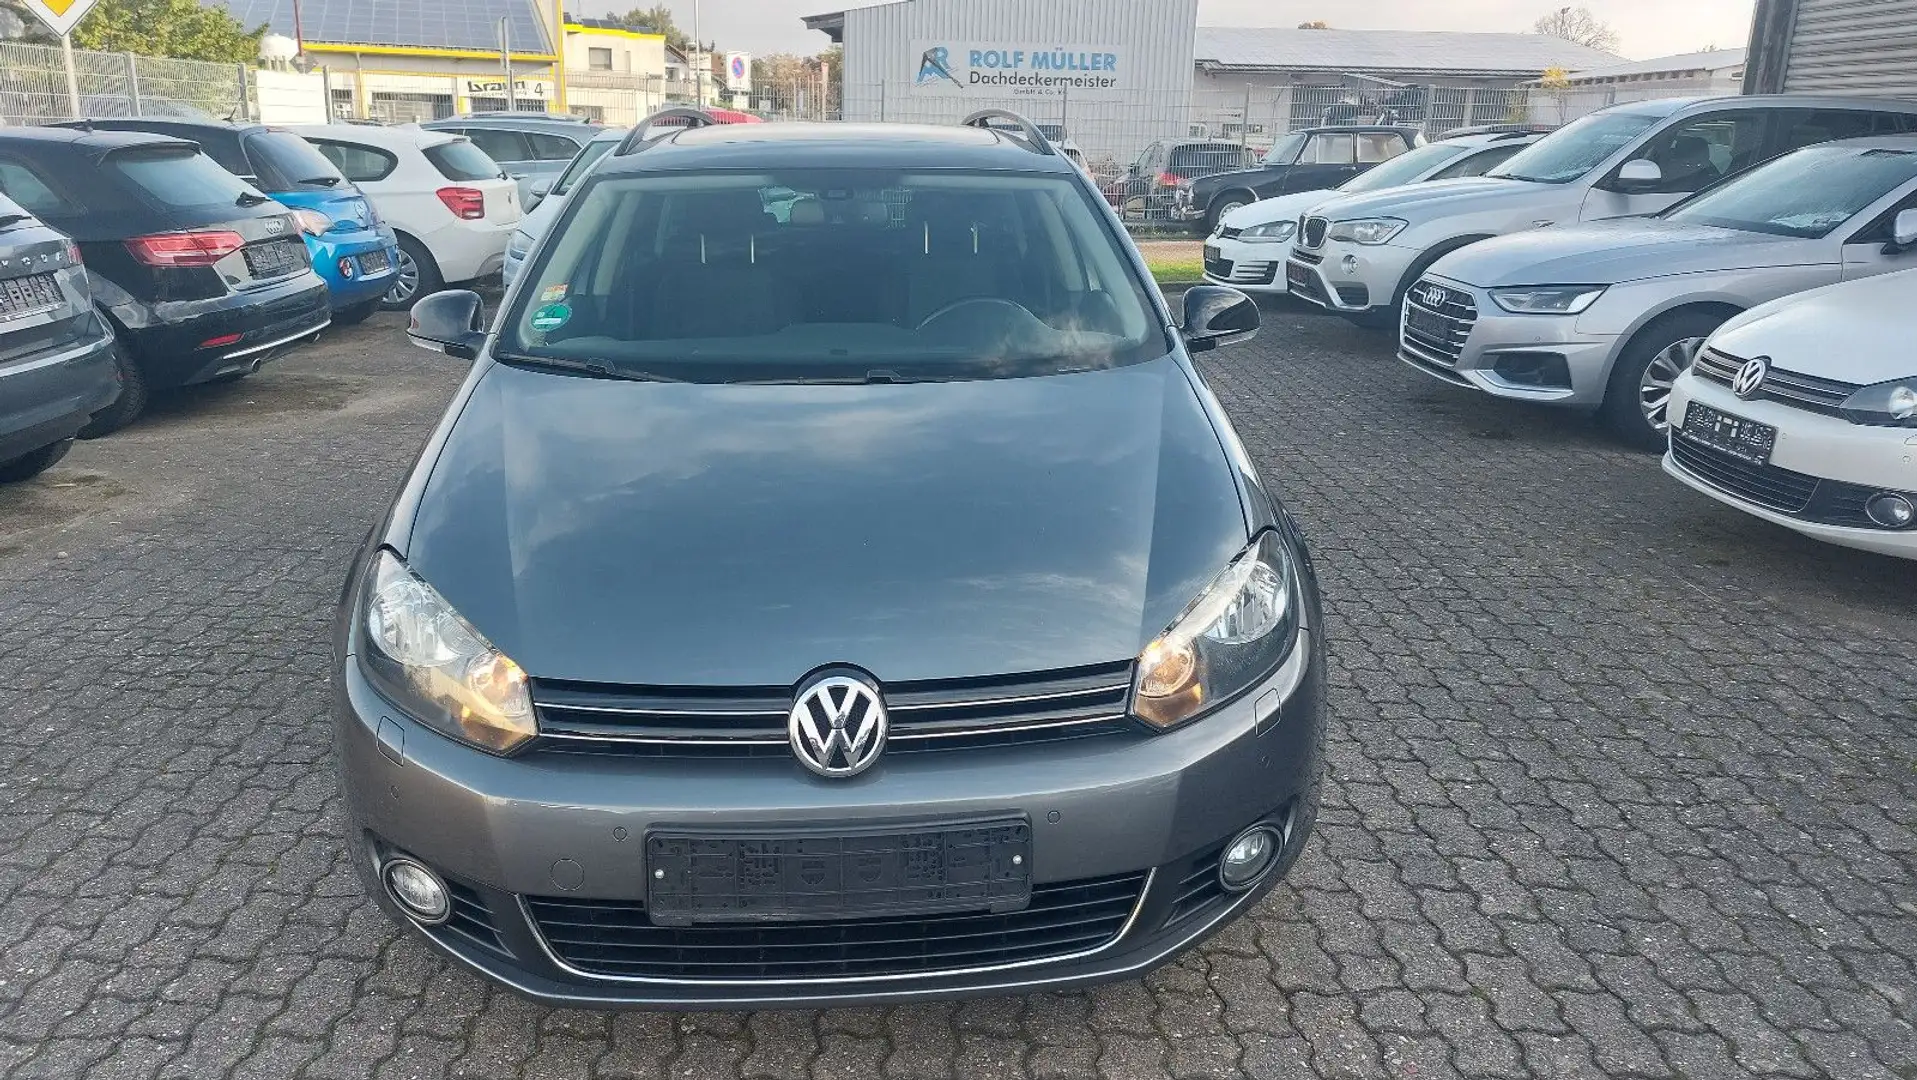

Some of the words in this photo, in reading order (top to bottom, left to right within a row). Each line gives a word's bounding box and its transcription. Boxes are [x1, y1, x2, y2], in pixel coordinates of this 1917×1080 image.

[969, 50, 1024, 69] ROLF
[1031, 47, 1117, 72] MÜLLER
[534, 83, 544, 97] 4
[969, 71, 1117, 88] Dachdeckermeister
[794, 682, 883, 773] VW
